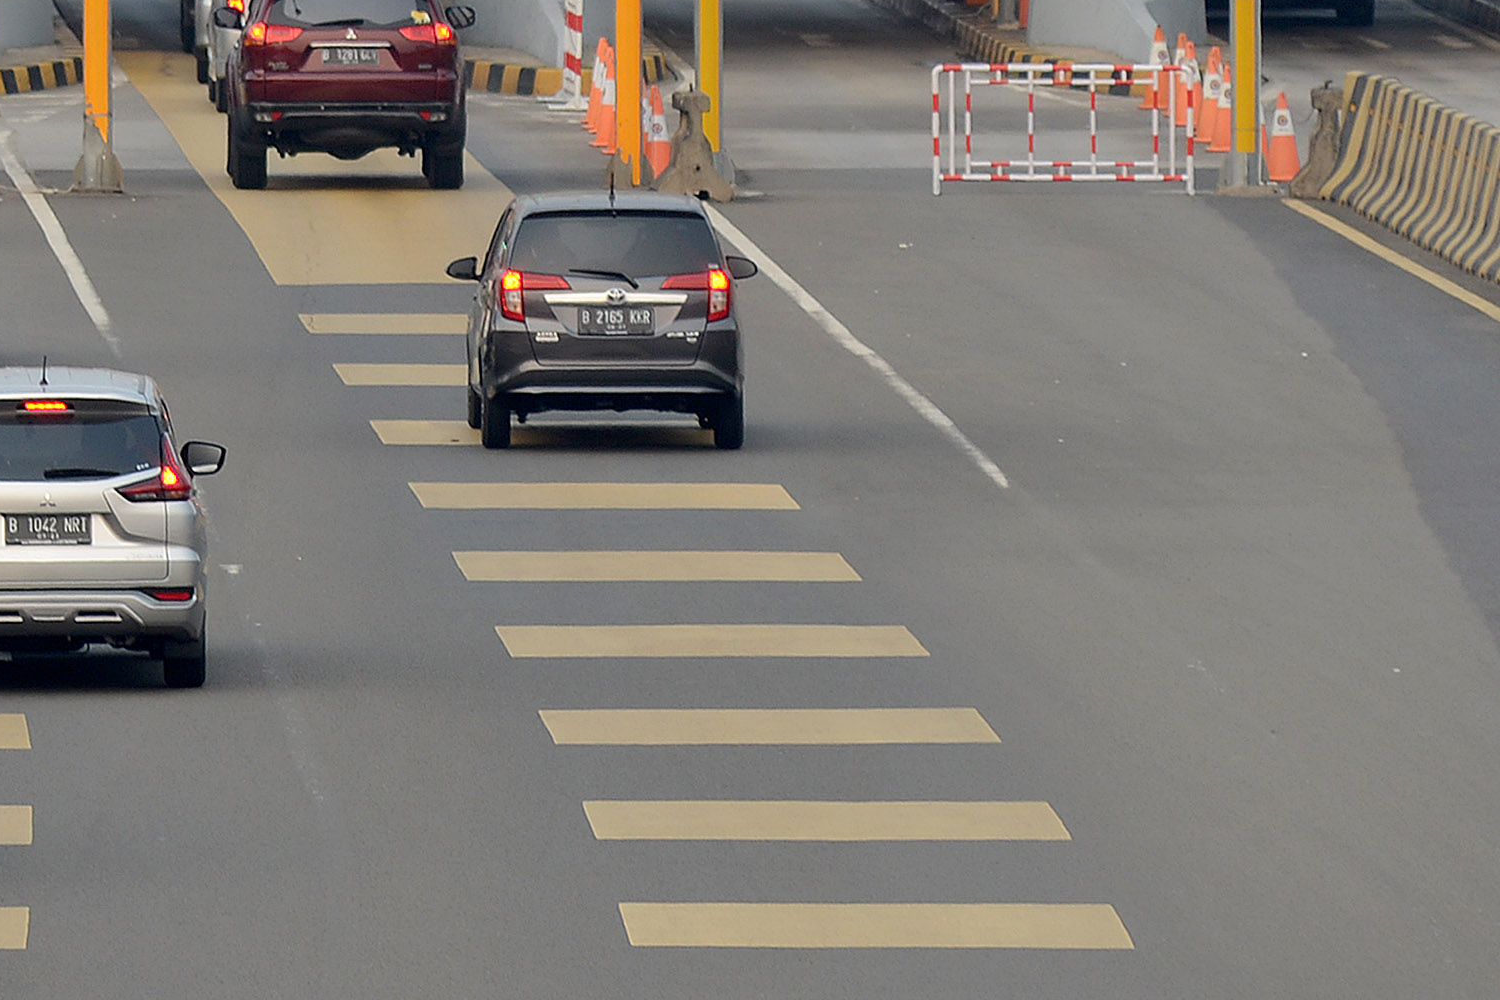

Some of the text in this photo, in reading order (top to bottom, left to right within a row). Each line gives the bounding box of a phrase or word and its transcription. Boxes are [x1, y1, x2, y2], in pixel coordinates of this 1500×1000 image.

[582, 310, 651, 325] B 2165 KKR
[8, 516, 87, 533] B 1042 NRT
